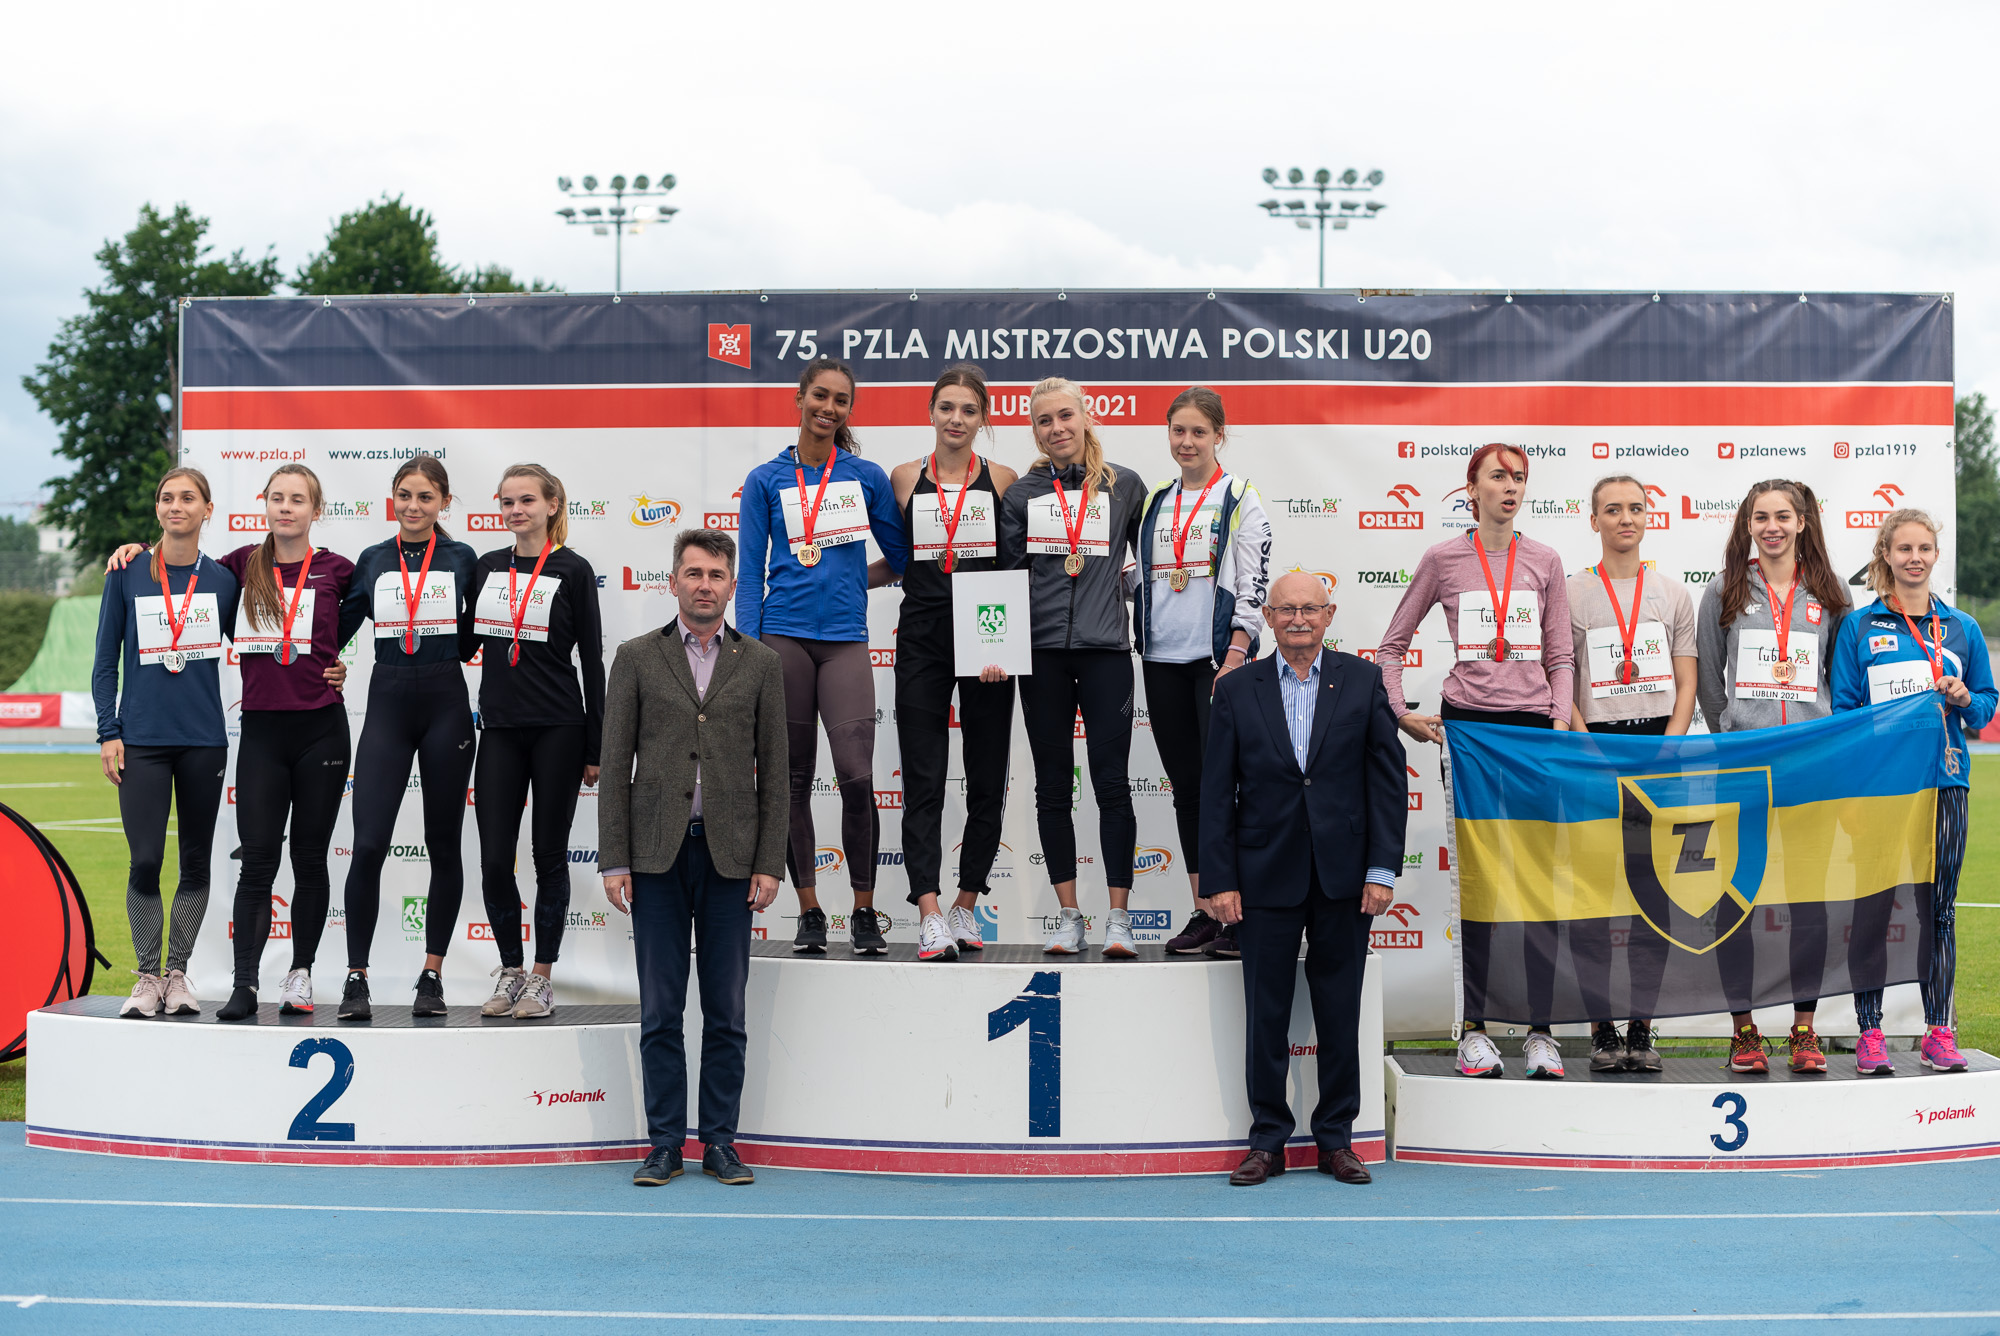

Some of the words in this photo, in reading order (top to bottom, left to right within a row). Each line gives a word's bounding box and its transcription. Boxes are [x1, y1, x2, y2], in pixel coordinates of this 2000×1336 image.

[776, 329, 828, 361] 75.
[843, 328, 931, 361] PZLA
[943, 327, 1210, 361] MISTRZOSTWA
[1221, 327, 1350, 360] POLSKI
[1364, 328, 1433, 361] U20
[990, 394, 1033, 416] LUB
[1084, 394, 1137, 417] 2021
[220, 447, 307, 463] www.pzla.pl
[1615, 444, 1690, 460] pzlawideo
[1740, 444, 1807, 460] pzlanews
[1854, 443, 1918, 460] pzla1919
[567, 501, 590, 516] blin
[1288, 498, 1321, 514] lublin
[1531, 499, 1564, 514] lublin
[1695, 499, 1740, 511] lubelski
[641, 505, 671, 521] LOTTO
[1361, 513, 1420, 528] ORLEN
[1849, 512, 1885, 527] ORL
[231, 516, 269, 530] ORL
[470, 516, 508, 530] ORL
[706, 514, 739, 529] ORL
[835, 534, 854, 544] 2021
[960, 549, 979, 557] 2021
[1045, 545, 1071, 554] LUBLIN
[636, 570, 671, 582] lubels
[1683, 571, 1716, 584] TOTA
[421, 626, 440, 635] 2021
[489, 627, 513, 637] LUBLIN
[186, 651, 205, 660] 2021
[1610, 685, 1637, 695] LUBLIN
[1638, 683, 1657, 692] 2021
[1890, 678, 1923, 695] lublin
[1752, 690, 1779, 698] LUBLIN
[1780, 691, 1799, 700] 2021
[874, 793, 902, 807] ORL
[388, 845, 427, 857] TOTAL
[1156, 913, 1167, 926] 3
[1130, 933, 1161, 941] LUBLIN
[987, 971, 1061, 1138] 1
[287, 1037, 355, 1141] 2
[547, 1088, 607, 1107] polanik
[1710, 1091, 1749, 1152] 3
[1928, 1105, 1976, 1125] polanik
